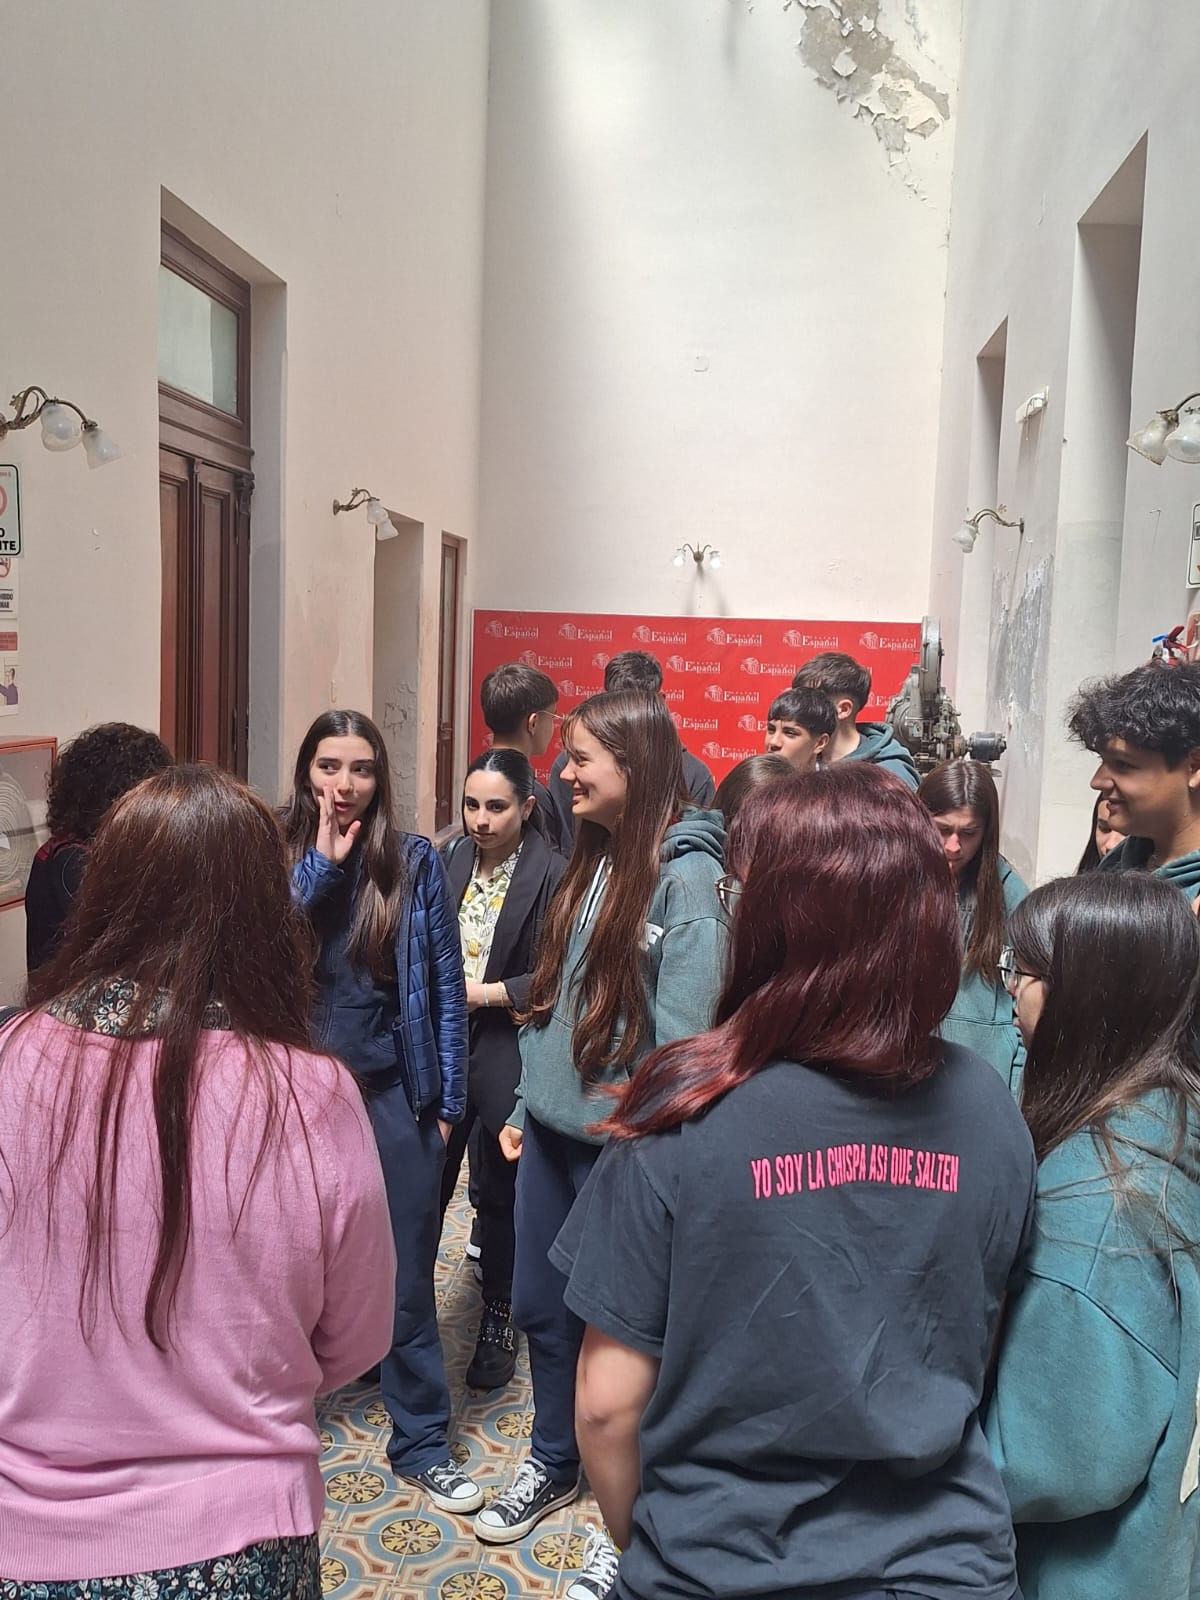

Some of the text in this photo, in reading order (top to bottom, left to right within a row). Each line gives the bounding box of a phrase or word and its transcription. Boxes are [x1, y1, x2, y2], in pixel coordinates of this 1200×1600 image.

[504, 626, 538, 639] Español
[577, 629, 613, 641] Español
[652, 631, 687, 644] Español
[726, 633, 762, 646] Español
[802, 635, 839, 648] Español
[880, 637, 916, 650] Español
[538, 655, 573, 668] Español
[685, 661, 721, 673] Español
[760, 663, 796, 676] Español
[724, 690, 760, 704] Español
[683, 718, 718, 731] Español
[751, 1144, 959, 1199] YO SOY LA CHISPA ASI QUE SALTEN
